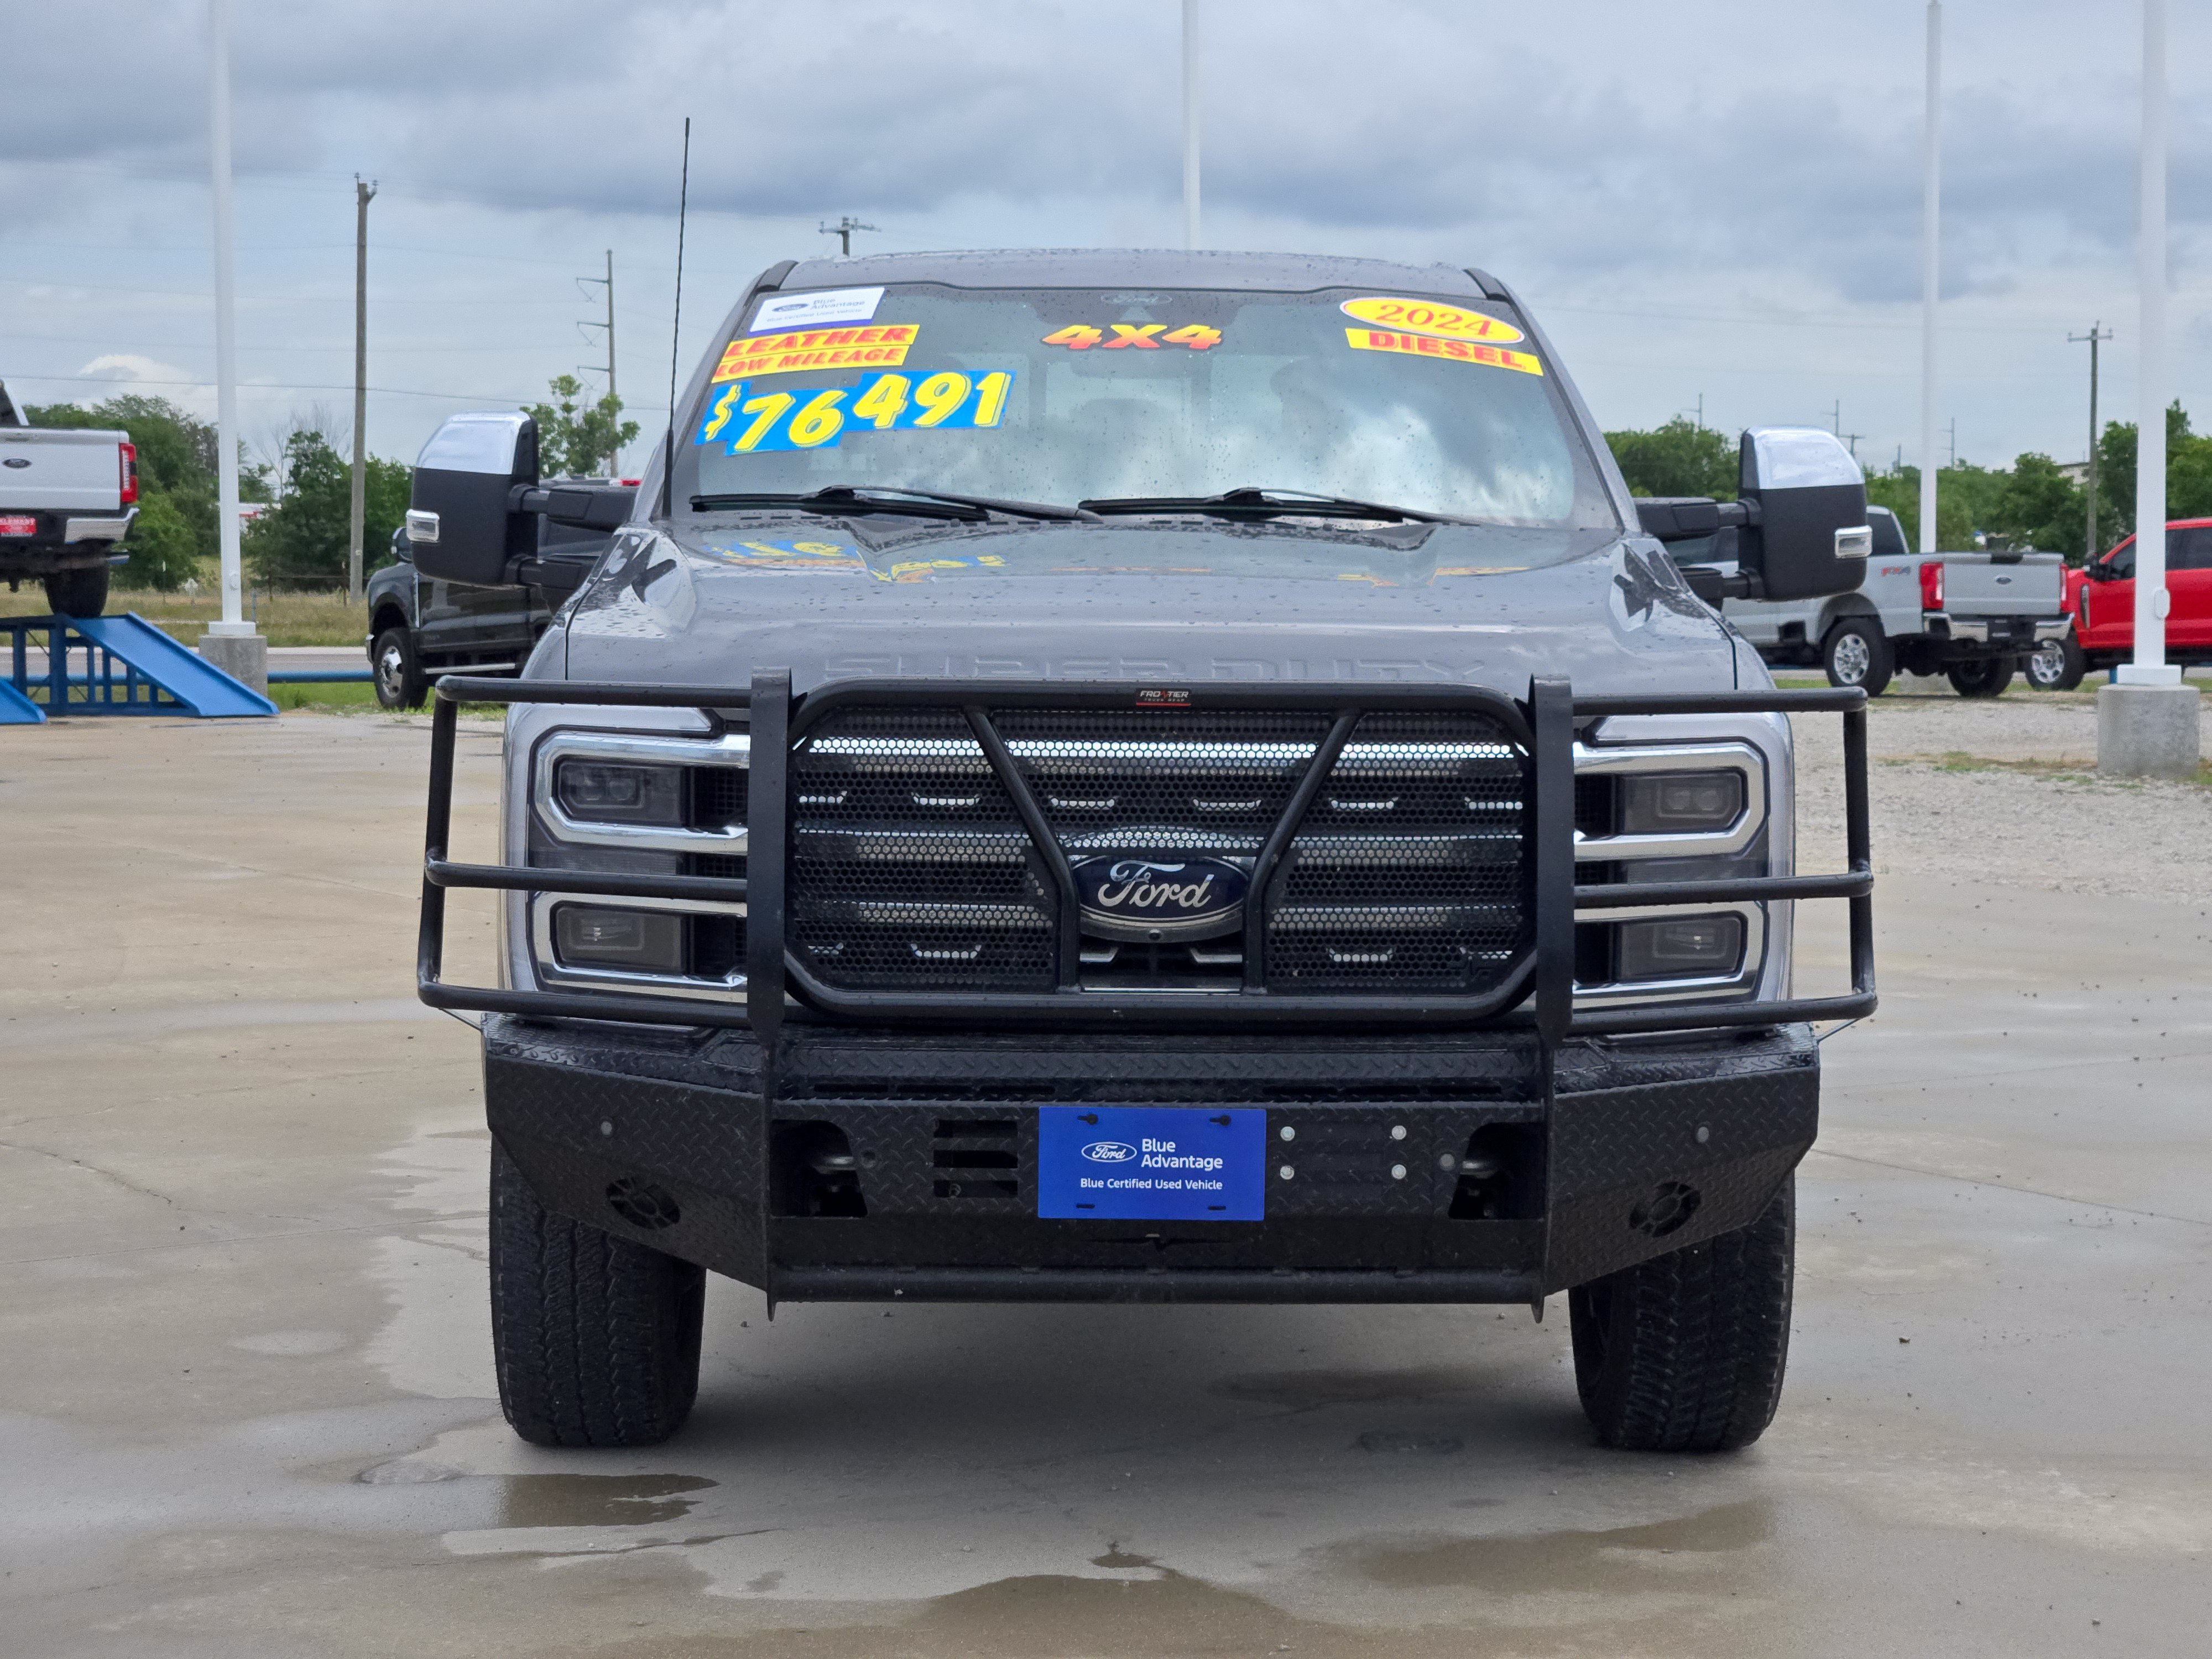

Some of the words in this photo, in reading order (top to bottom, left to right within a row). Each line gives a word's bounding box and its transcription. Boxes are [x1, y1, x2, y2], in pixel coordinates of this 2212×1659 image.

[810, 301, 865, 310] Advantage
[1376, 305, 1494, 336] 2024
[724, 327, 914, 358] LEATHER
[1042, 324, 1222, 349] 4X4
[713, 357, 775, 378] LOW
[777, 348, 904, 369] MILEAGE
[1369, 332, 1526, 370] DIESEL
[1098, 860, 1214, 907] Ford
[1092, 1144, 1126, 1159] Ford
[1142, 1138, 1176, 1152] Blue
[1141, 1154, 1223, 1171] Advantage
[1081, 1178, 1104, 1188] Blue
[1107, 1178, 1151, 1188] Certified
[1155, 1179, 1182, 1189] Used
[1185, 1180, 1223, 1190] Vehicle
